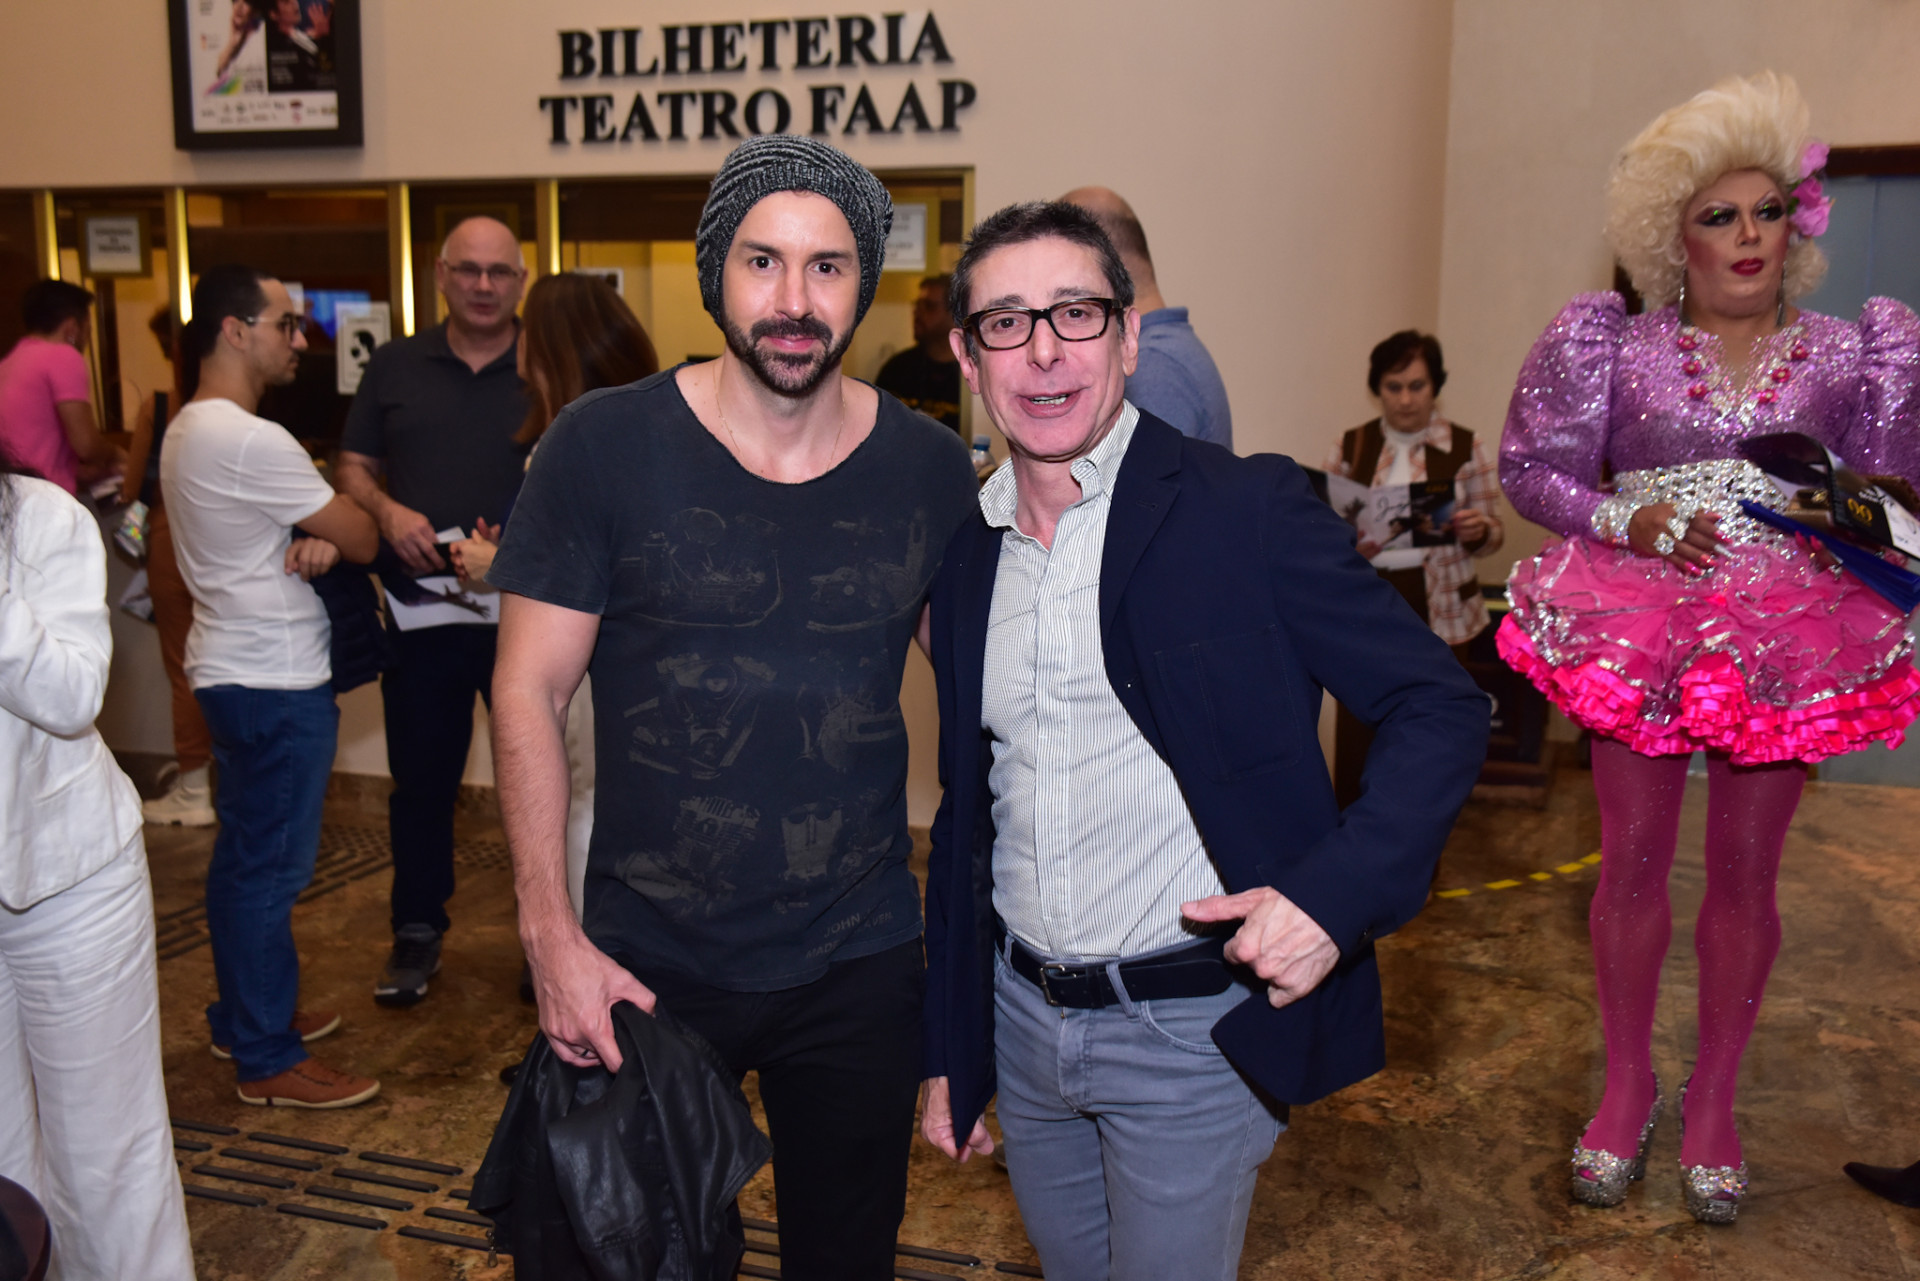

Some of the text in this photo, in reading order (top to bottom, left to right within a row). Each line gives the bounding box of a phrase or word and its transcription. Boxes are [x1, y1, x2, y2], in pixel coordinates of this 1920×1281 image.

[558, 11, 954, 79] BILHETERIA
[539, 79, 977, 144] TEATRO FAAP
[824, 913, 861, 938] JOHN
